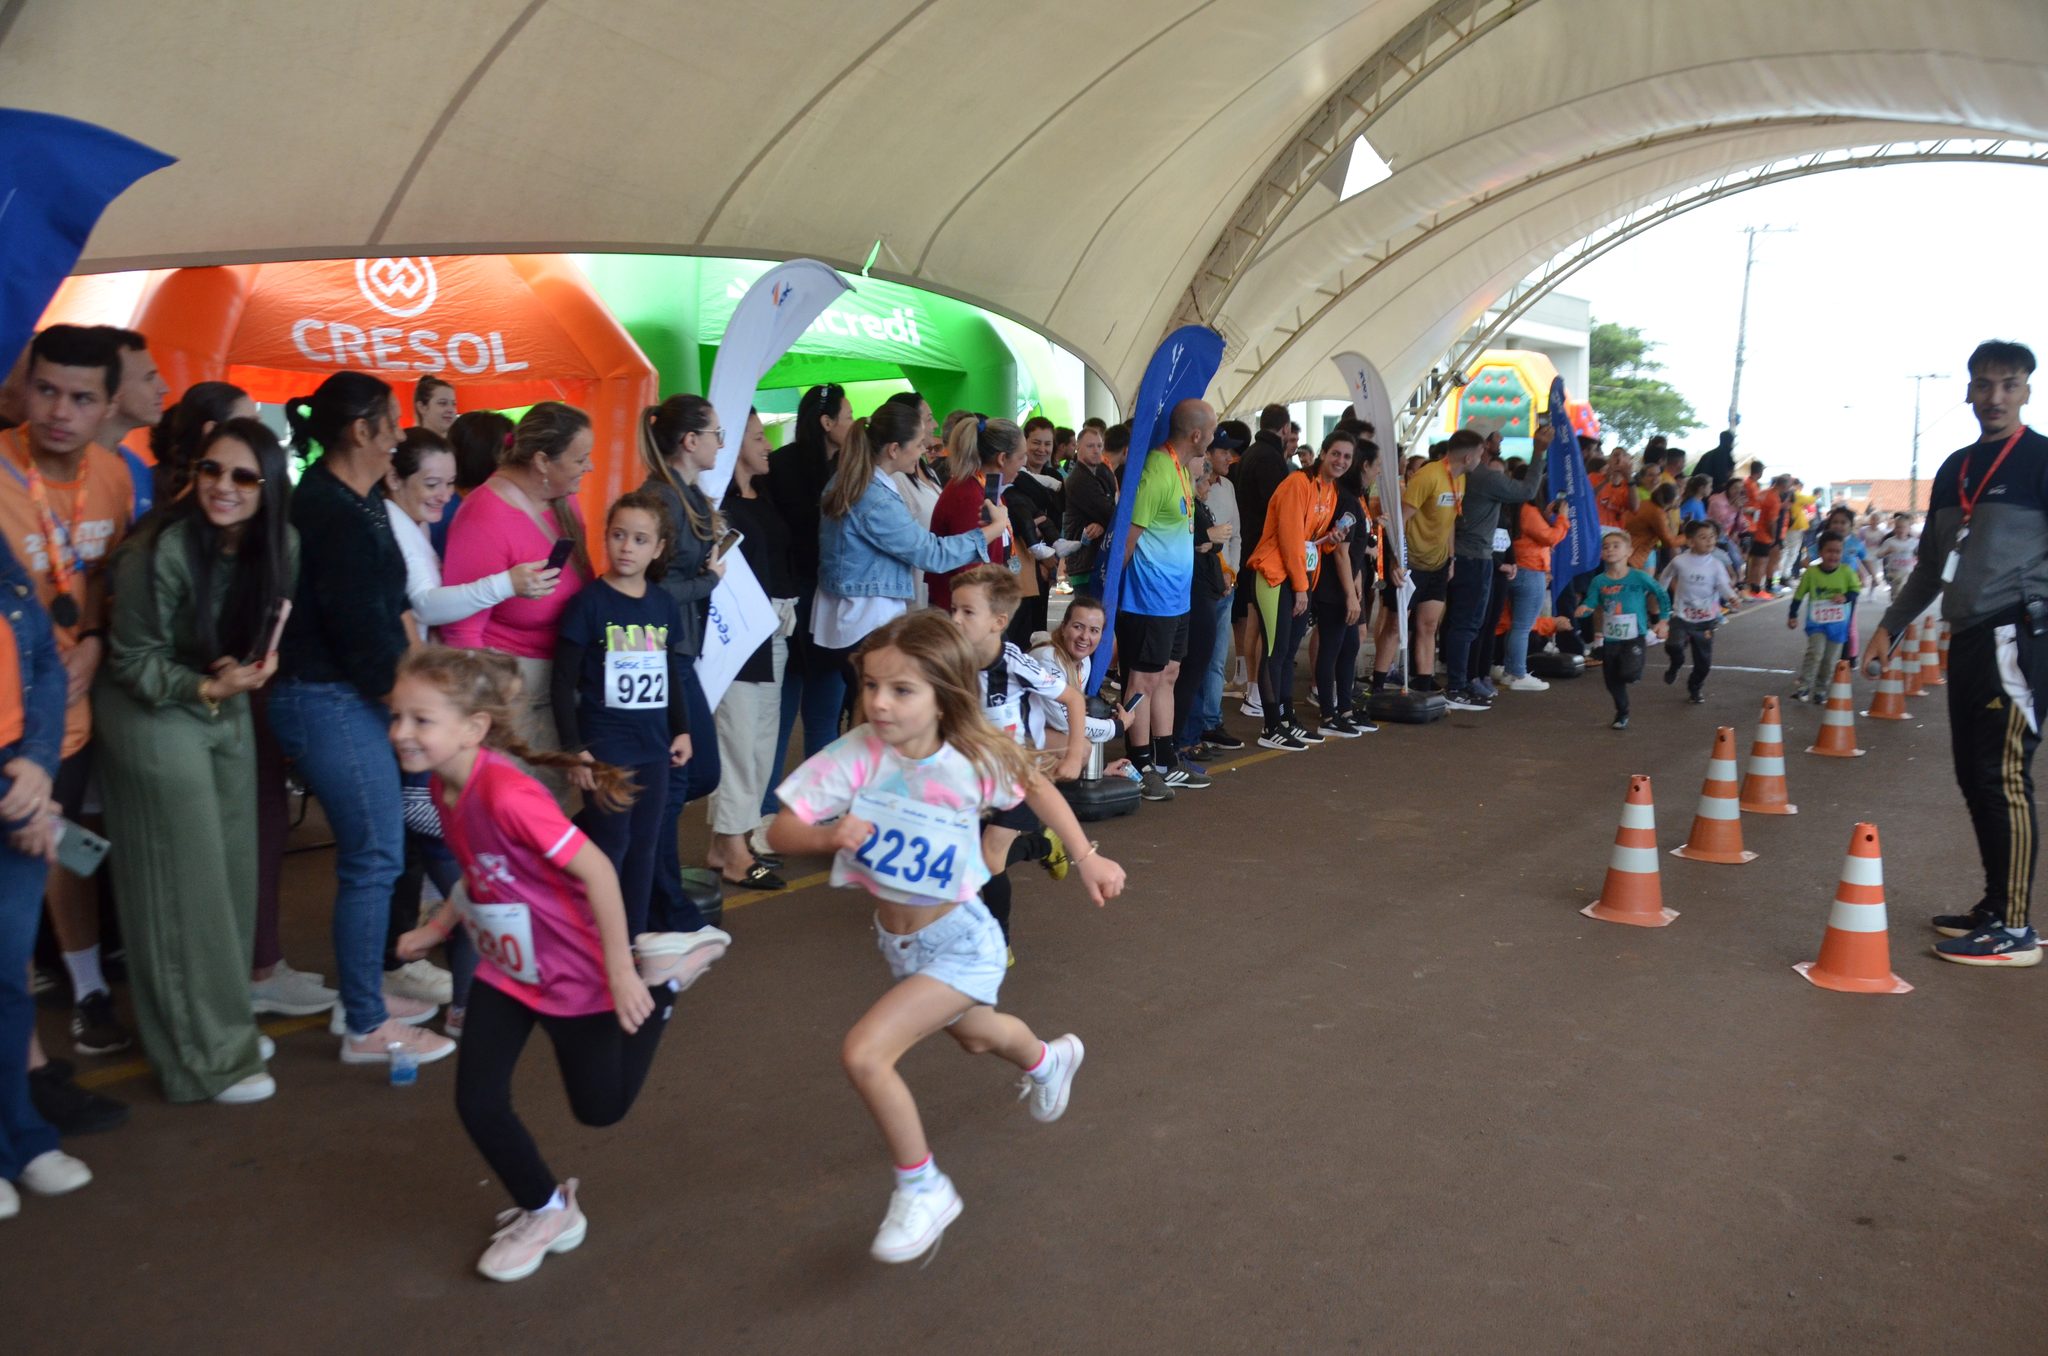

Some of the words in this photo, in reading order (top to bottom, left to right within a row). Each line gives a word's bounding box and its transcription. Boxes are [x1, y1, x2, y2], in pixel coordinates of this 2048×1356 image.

[291, 318, 530, 374] CRESOL
[806, 307, 921, 346] icredi
[707, 601, 731, 645] Feco
[1606, 622, 1631, 637] 367
[617, 673, 664, 703] 922
[855, 822, 957, 889] 2234
